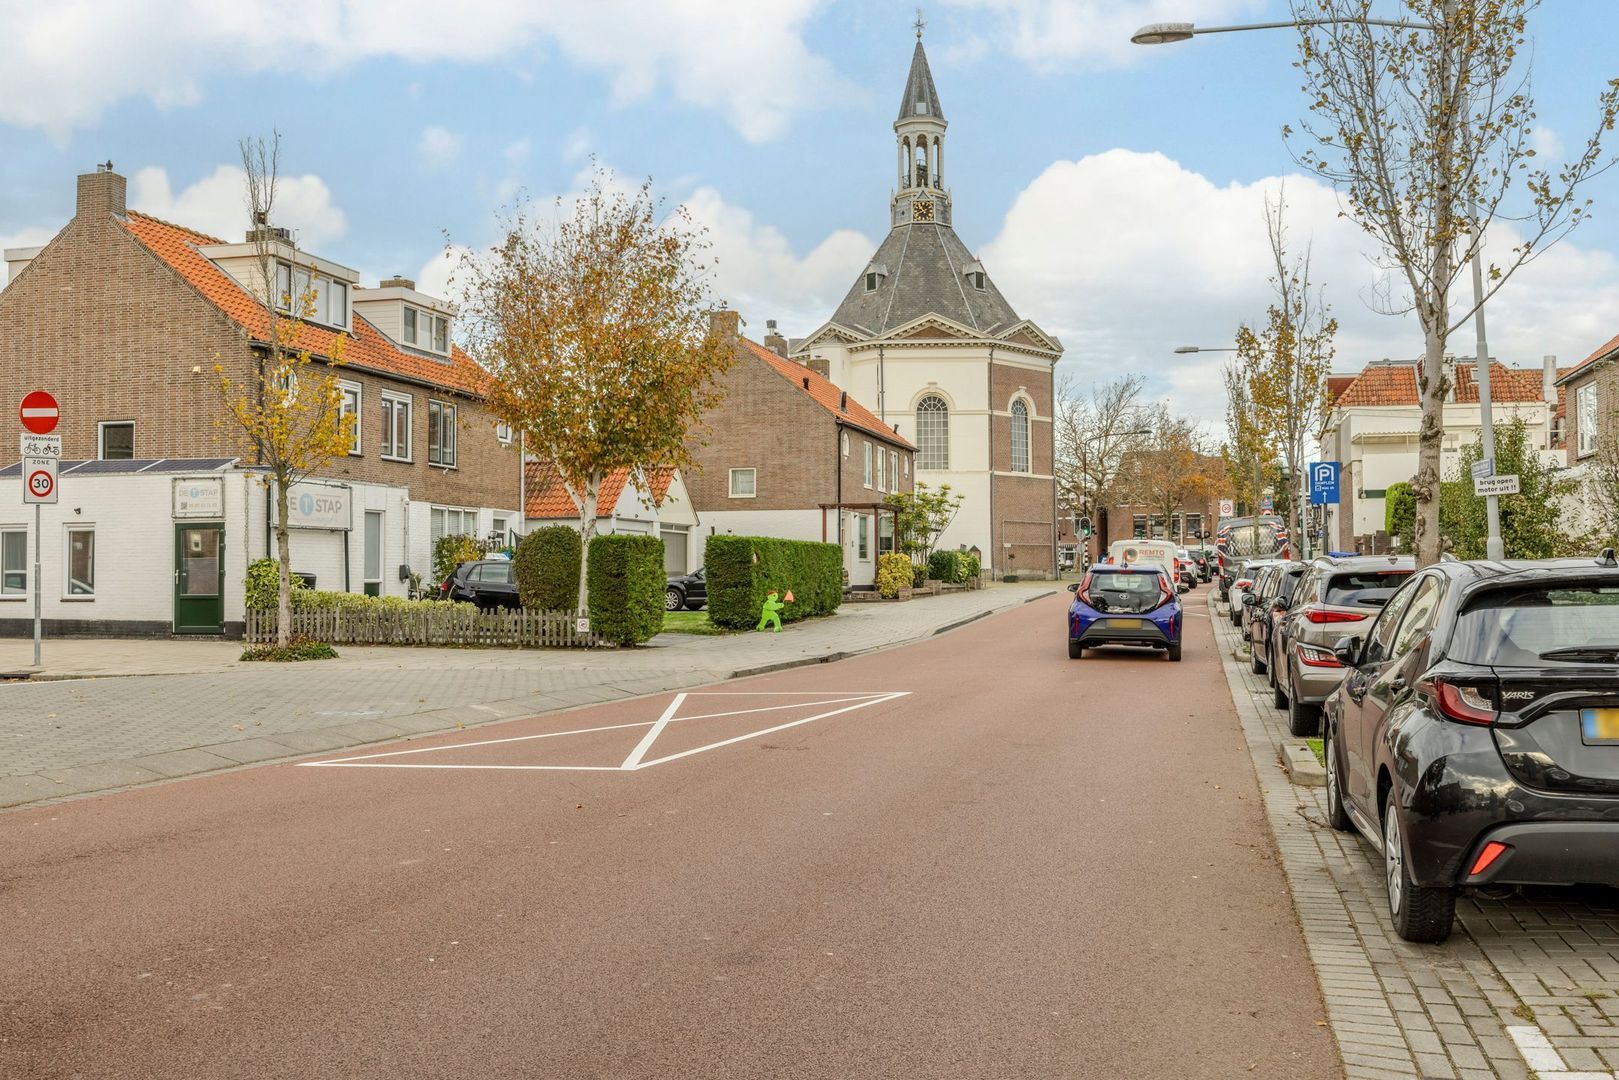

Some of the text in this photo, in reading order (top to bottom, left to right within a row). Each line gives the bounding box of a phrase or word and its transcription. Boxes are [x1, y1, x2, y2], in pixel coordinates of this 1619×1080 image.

[33, 478, 49, 489] 30
[315, 498, 342, 514] STAP
[1501, 691, 1535, 700] YARIS
